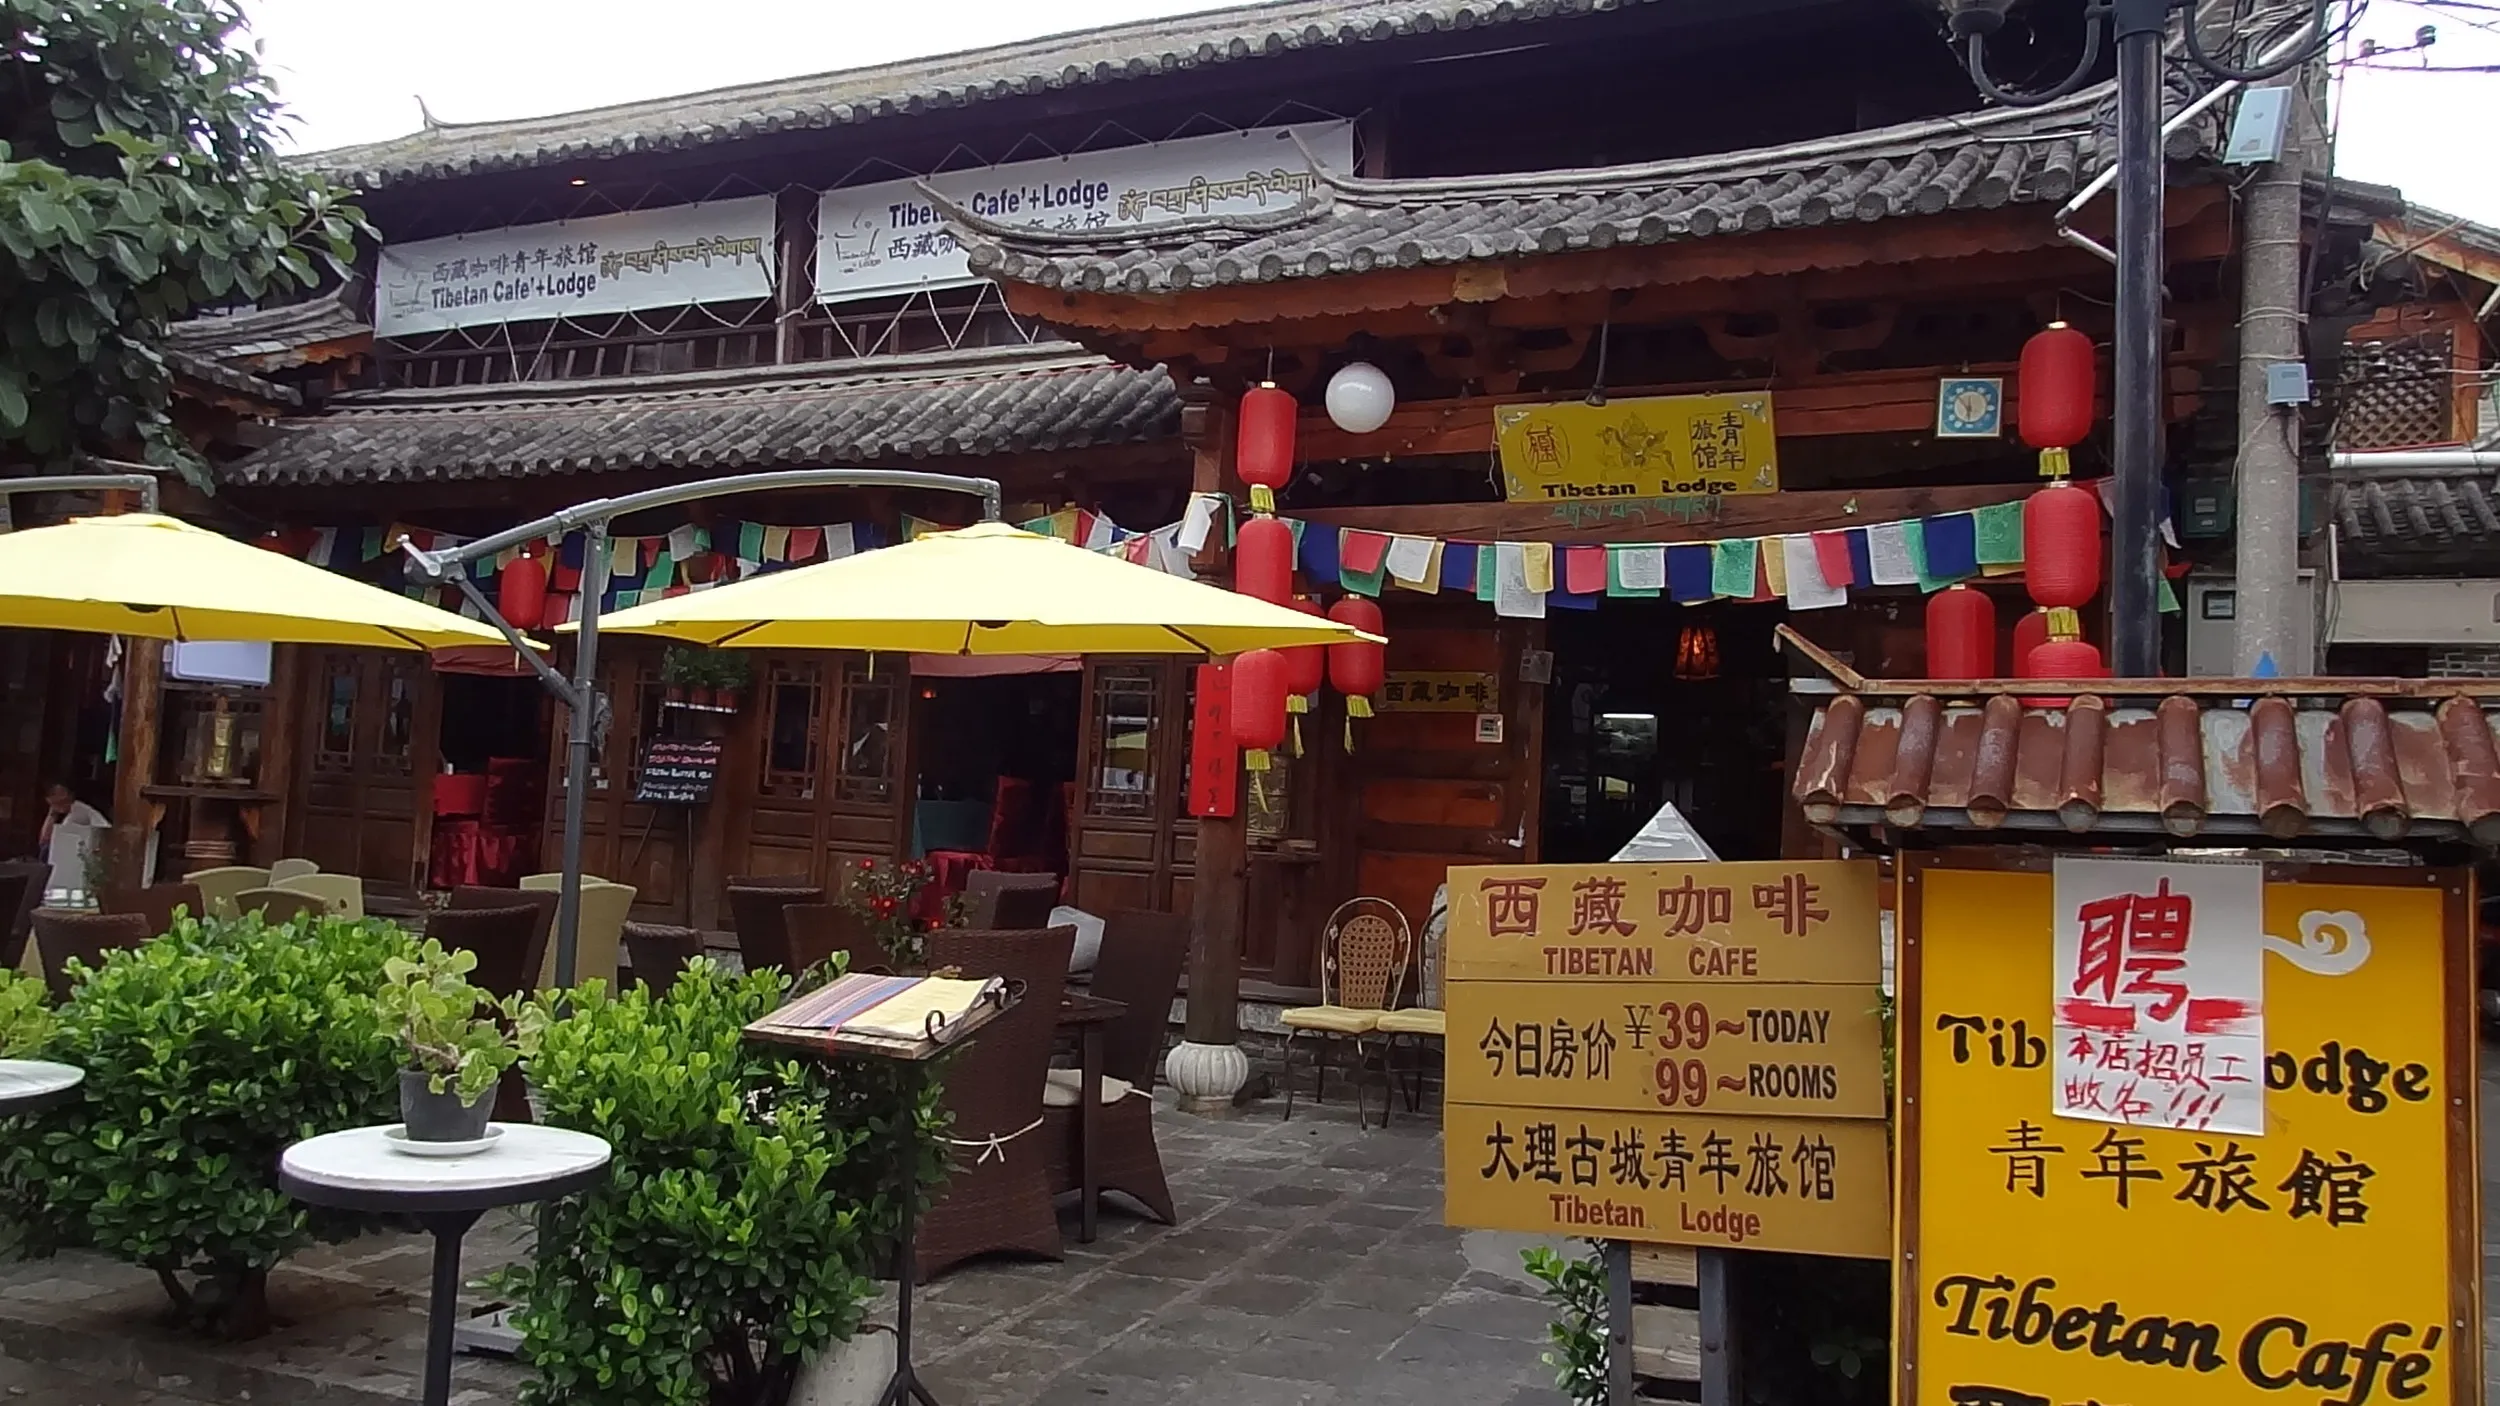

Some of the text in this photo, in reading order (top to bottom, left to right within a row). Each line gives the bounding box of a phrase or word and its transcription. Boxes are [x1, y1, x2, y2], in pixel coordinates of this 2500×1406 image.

[432, 242, 599, 283] 西藏咖啡青年旅馆
[431, 285, 488, 309] Tibetan
[1541, 478, 1738, 498] Tibetan Lodge
[1480, 873, 1830, 938] 西藏咖啡
[1543, 947, 1758, 976] TIBETAN CAFE
[2072, 876, 2193, 1022] 聘
[1479, 1016, 1617, 1081] 今日房价
[1747, 1009, 1830, 1044] TODAY
[1748, 1063, 1838, 1100] ROOMS
[2066, 1030, 2253, 1092] 本店招员工
[2265, 1040, 2432, 1115] odge
[1480, 1120, 1837, 1201] 大理古城青年旅馆
[1987, 1119, 2377, 1228] 青年旅館
[1548, 1194, 1761, 1243] Tibetan Lodge
[1934, 1275, 2227, 1374] Tibetan
